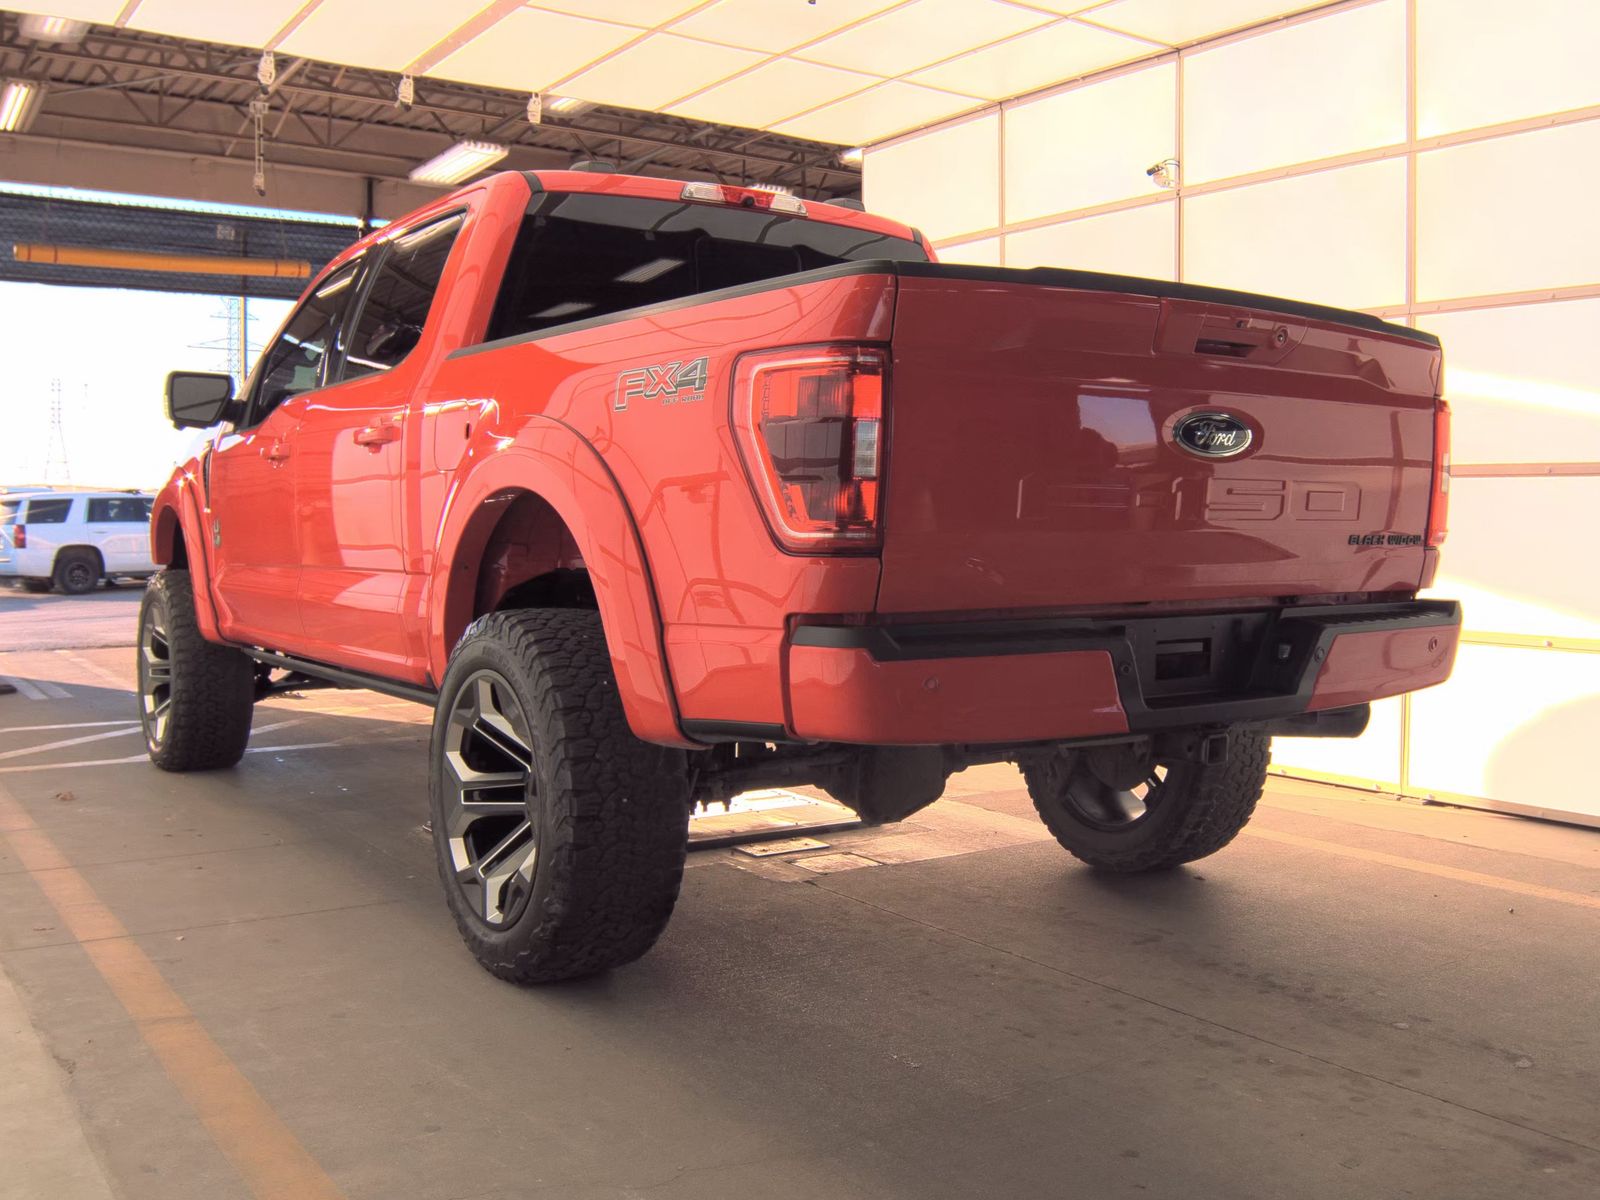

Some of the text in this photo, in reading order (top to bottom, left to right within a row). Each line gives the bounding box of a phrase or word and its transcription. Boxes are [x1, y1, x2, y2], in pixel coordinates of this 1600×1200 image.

[614, 356, 709, 411] FX4
[1191, 421, 1237, 447] Ford
[1348, 534, 1421, 545] BLACK WIDOW
